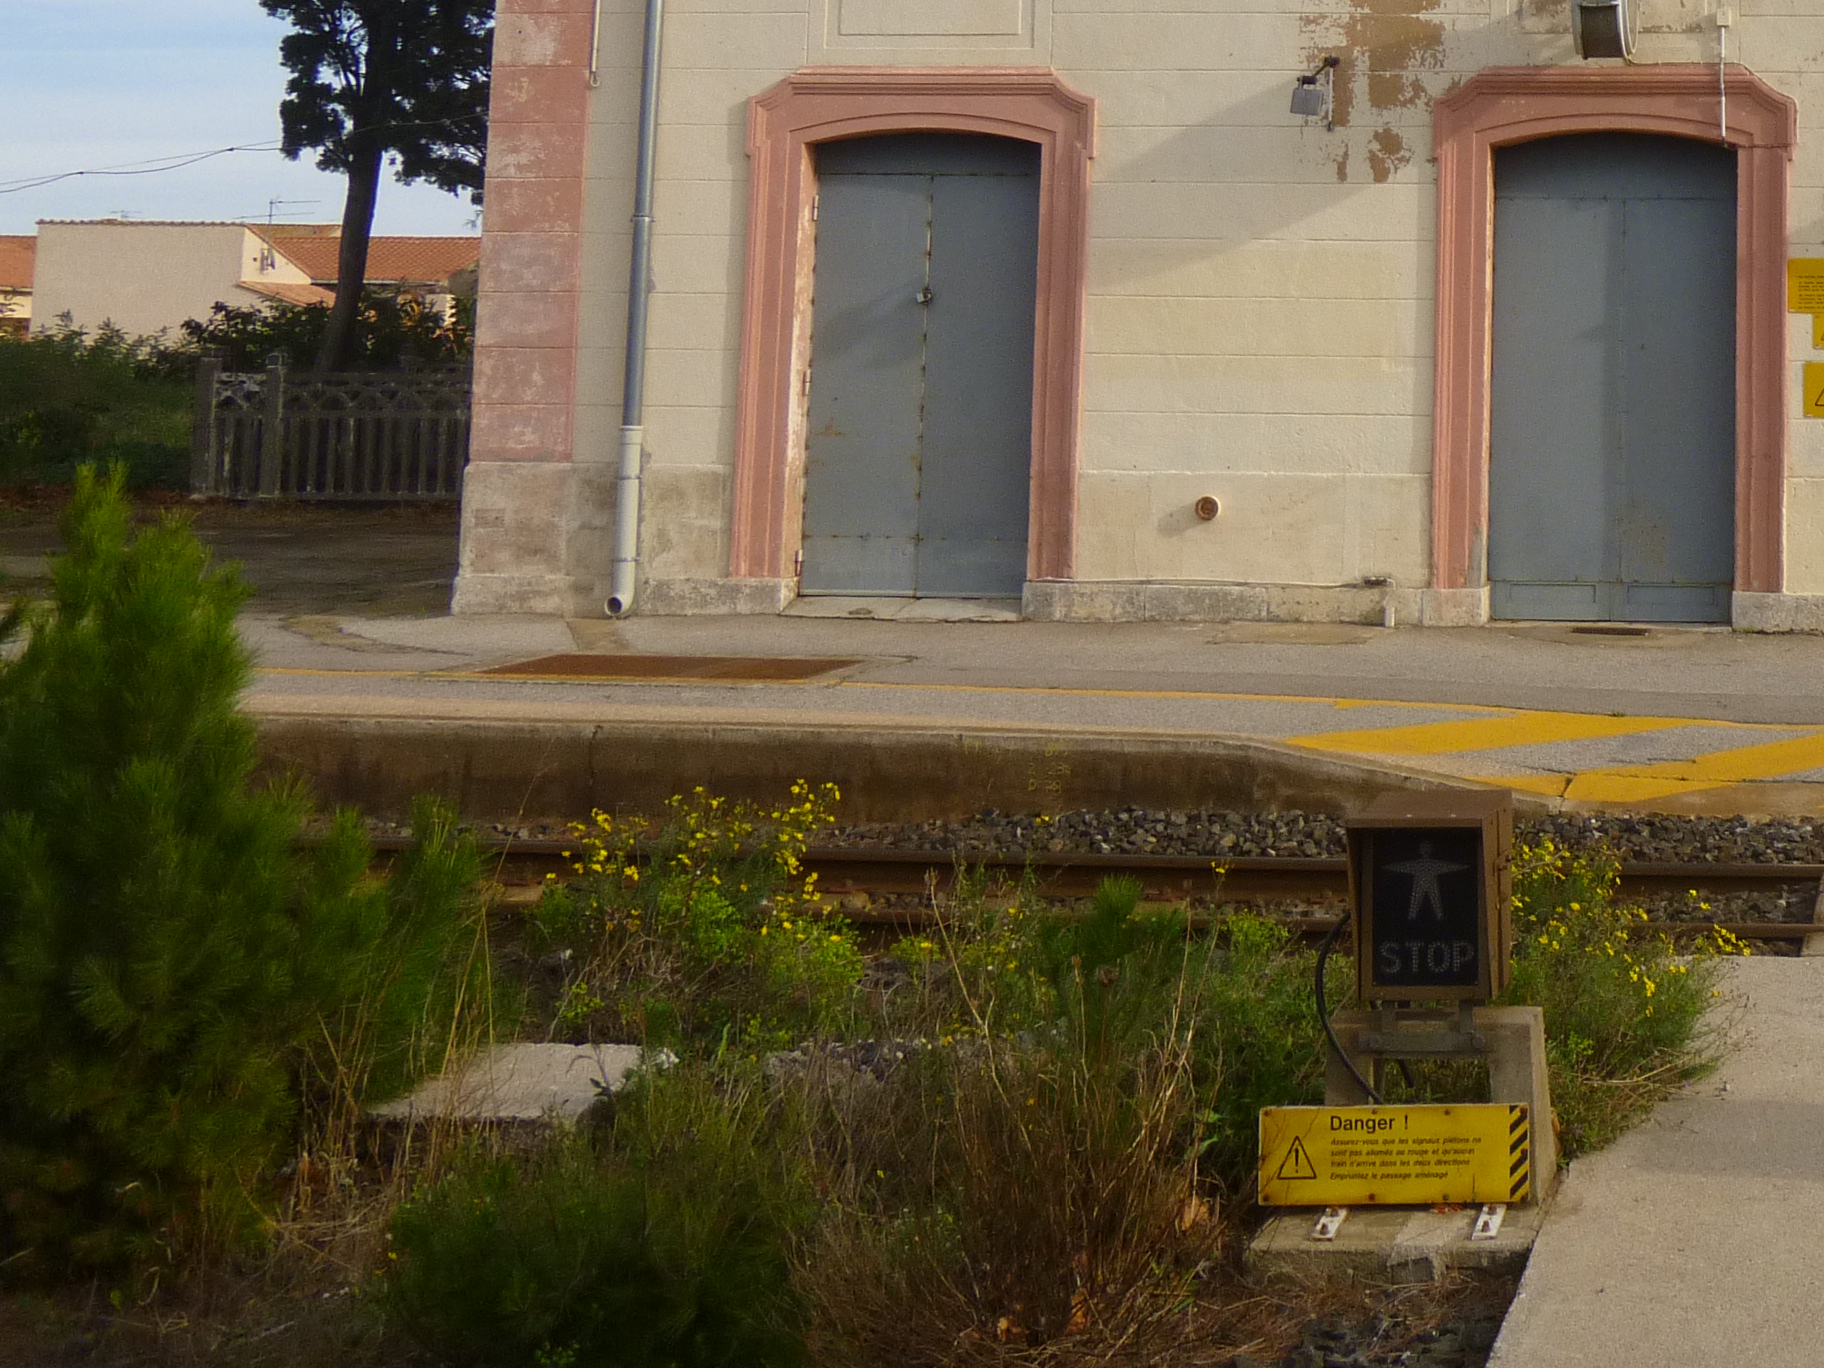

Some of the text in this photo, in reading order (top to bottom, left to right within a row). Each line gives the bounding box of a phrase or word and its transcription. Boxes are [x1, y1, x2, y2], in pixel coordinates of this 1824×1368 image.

[1380, 940, 1475, 974] STOP
[1330, 1115, 1395, 1133] Danger
[1382, 1138, 1395, 1147] que
[1398, 1137, 1409, 1145] les
[1412, 1137, 1440, 1146] signaux
[1331, 1149, 1347, 1157] sont
[1349, 1150, 1363, 1158] pas
[1407, 1149, 1429, 1157] rouge
[1331, 1160, 1347, 1168] train
[1434, 1158, 1471, 1166] directions
[1380, 1172, 1412, 1181] passage
